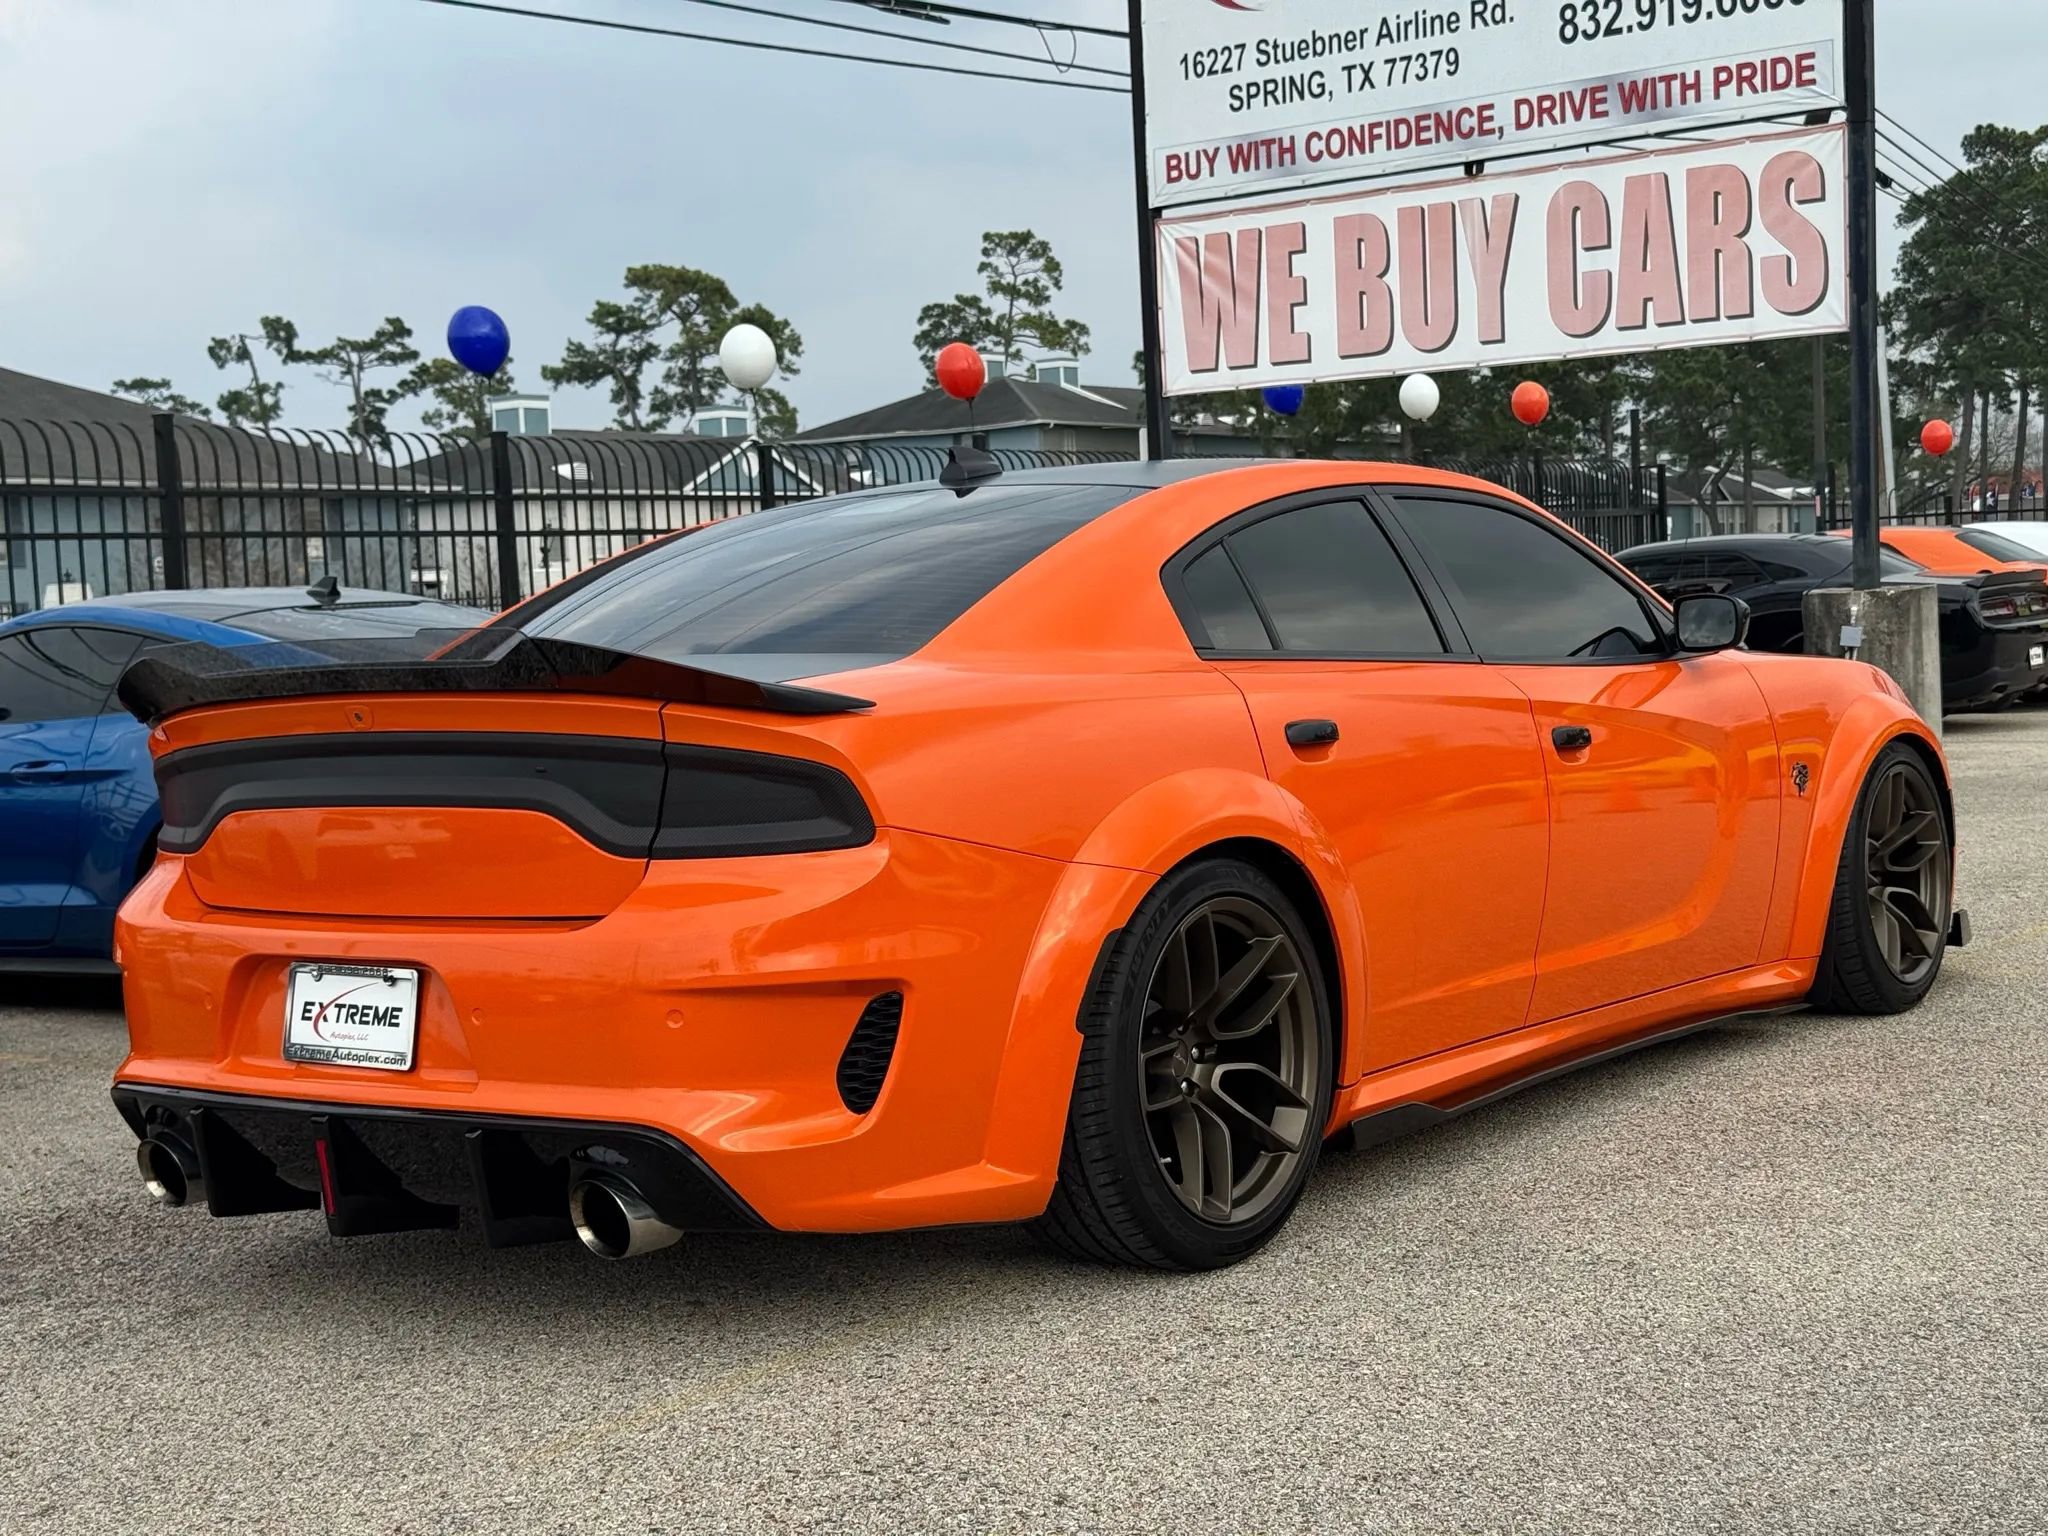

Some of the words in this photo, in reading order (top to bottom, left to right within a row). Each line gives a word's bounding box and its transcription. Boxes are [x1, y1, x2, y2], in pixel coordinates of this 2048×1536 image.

[1179, 43, 1247, 81] 16227
[1256, 27, 1369, 67] Stuebner
[1375, 10, 1461, 48] Airline
[1470, 0, 1515, 30] Rd.
[1228, 70, 1334, 113] SPRING,
[1342, 61, 1376, 95] TX
[1383, 47, 1460, 87] 77379
[1165, 146, 1220, 185] BUY
[1227, 135, 1297, 175] WITH
[1304, 103, 1504, 163] CONFIDENCE,
[1514, 84, 1609, 131] DRIVE
[1617, 69, 1701, 115] WITH
[1713, 51, 1817, 101] PRIDE
[1174, 220, 1313, 375] WE
[1333, 192, 1520, 360] BUY
[1545, 150, 1829, 338] CARS
[300, 1000, 404, 1028] EXTREME
